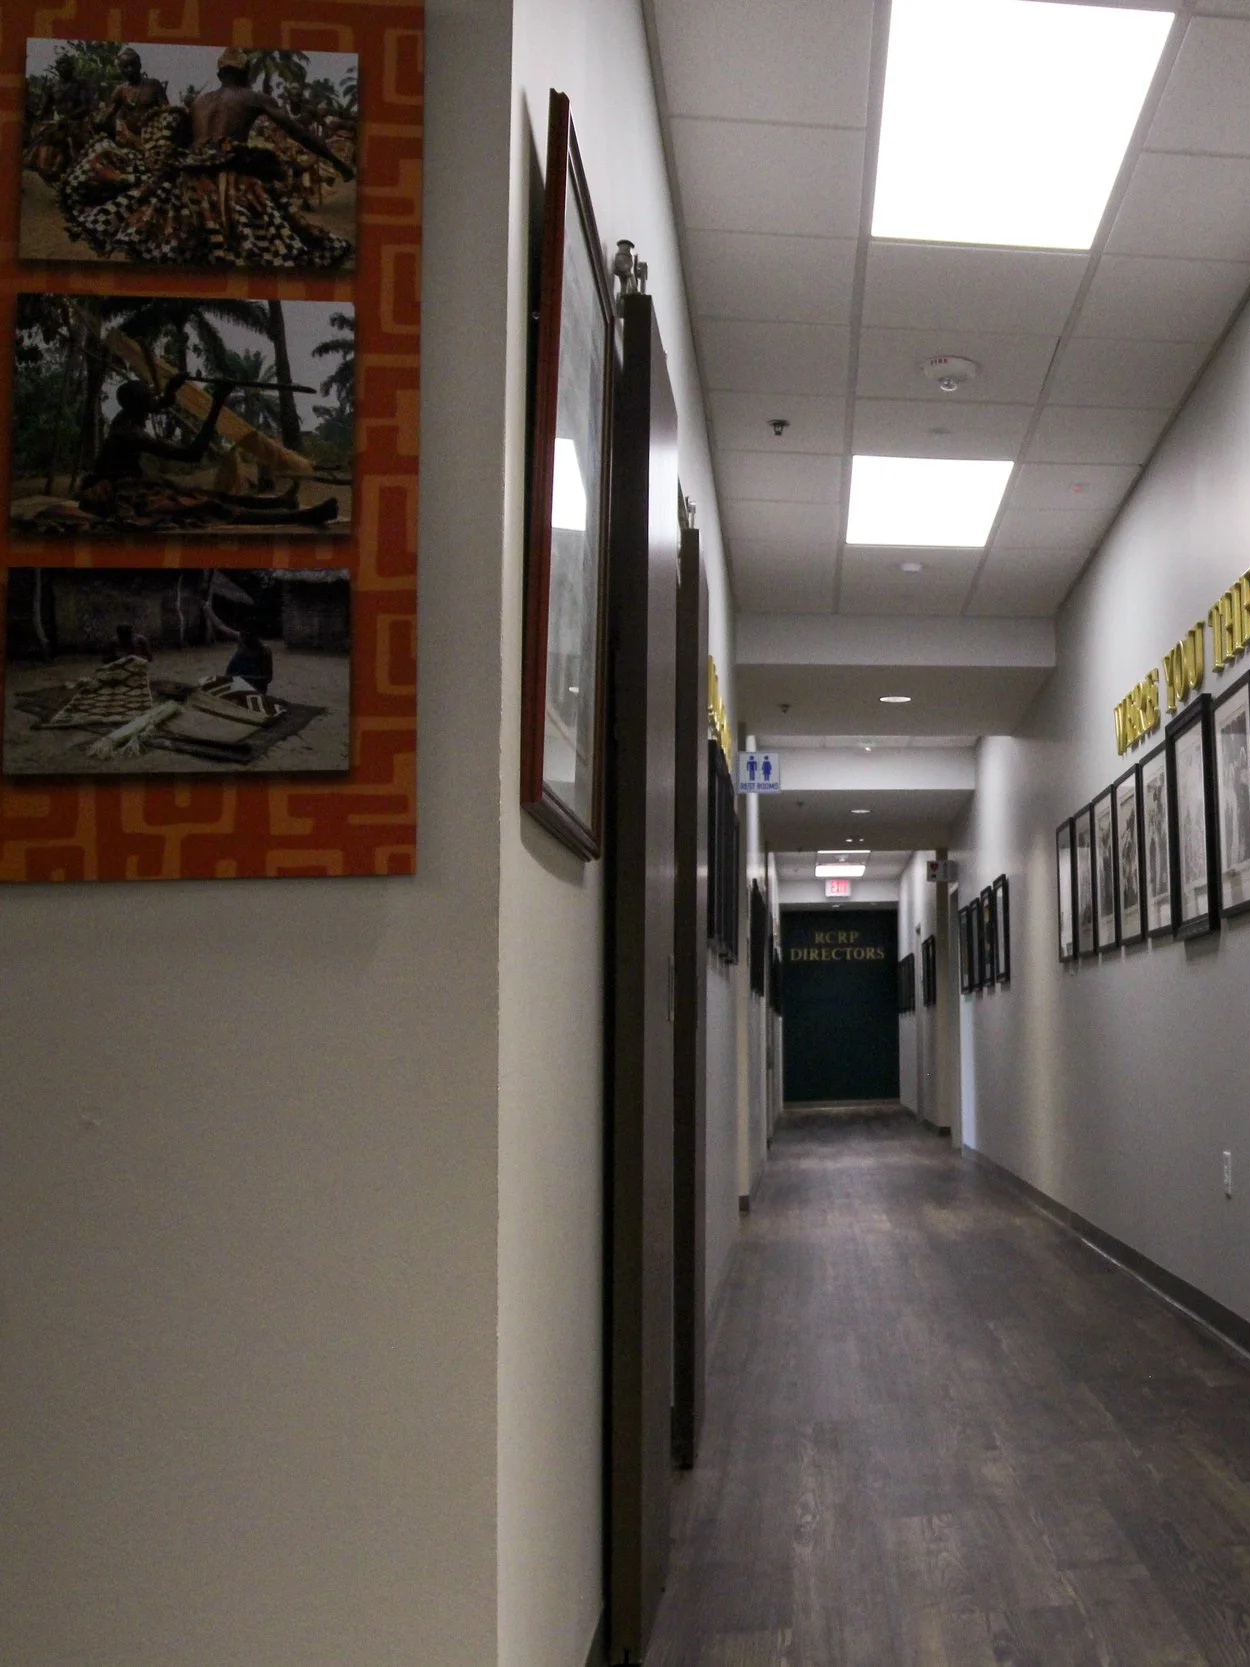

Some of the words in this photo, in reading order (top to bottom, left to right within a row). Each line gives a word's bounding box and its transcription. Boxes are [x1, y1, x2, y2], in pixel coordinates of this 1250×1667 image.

[1161, 621, 1205, 713] YOU
[830, 879, 847, 893] EXIT
[814, 931, 859, 944] RCRP
[789, 947, 885, 960] DIRECTORS
